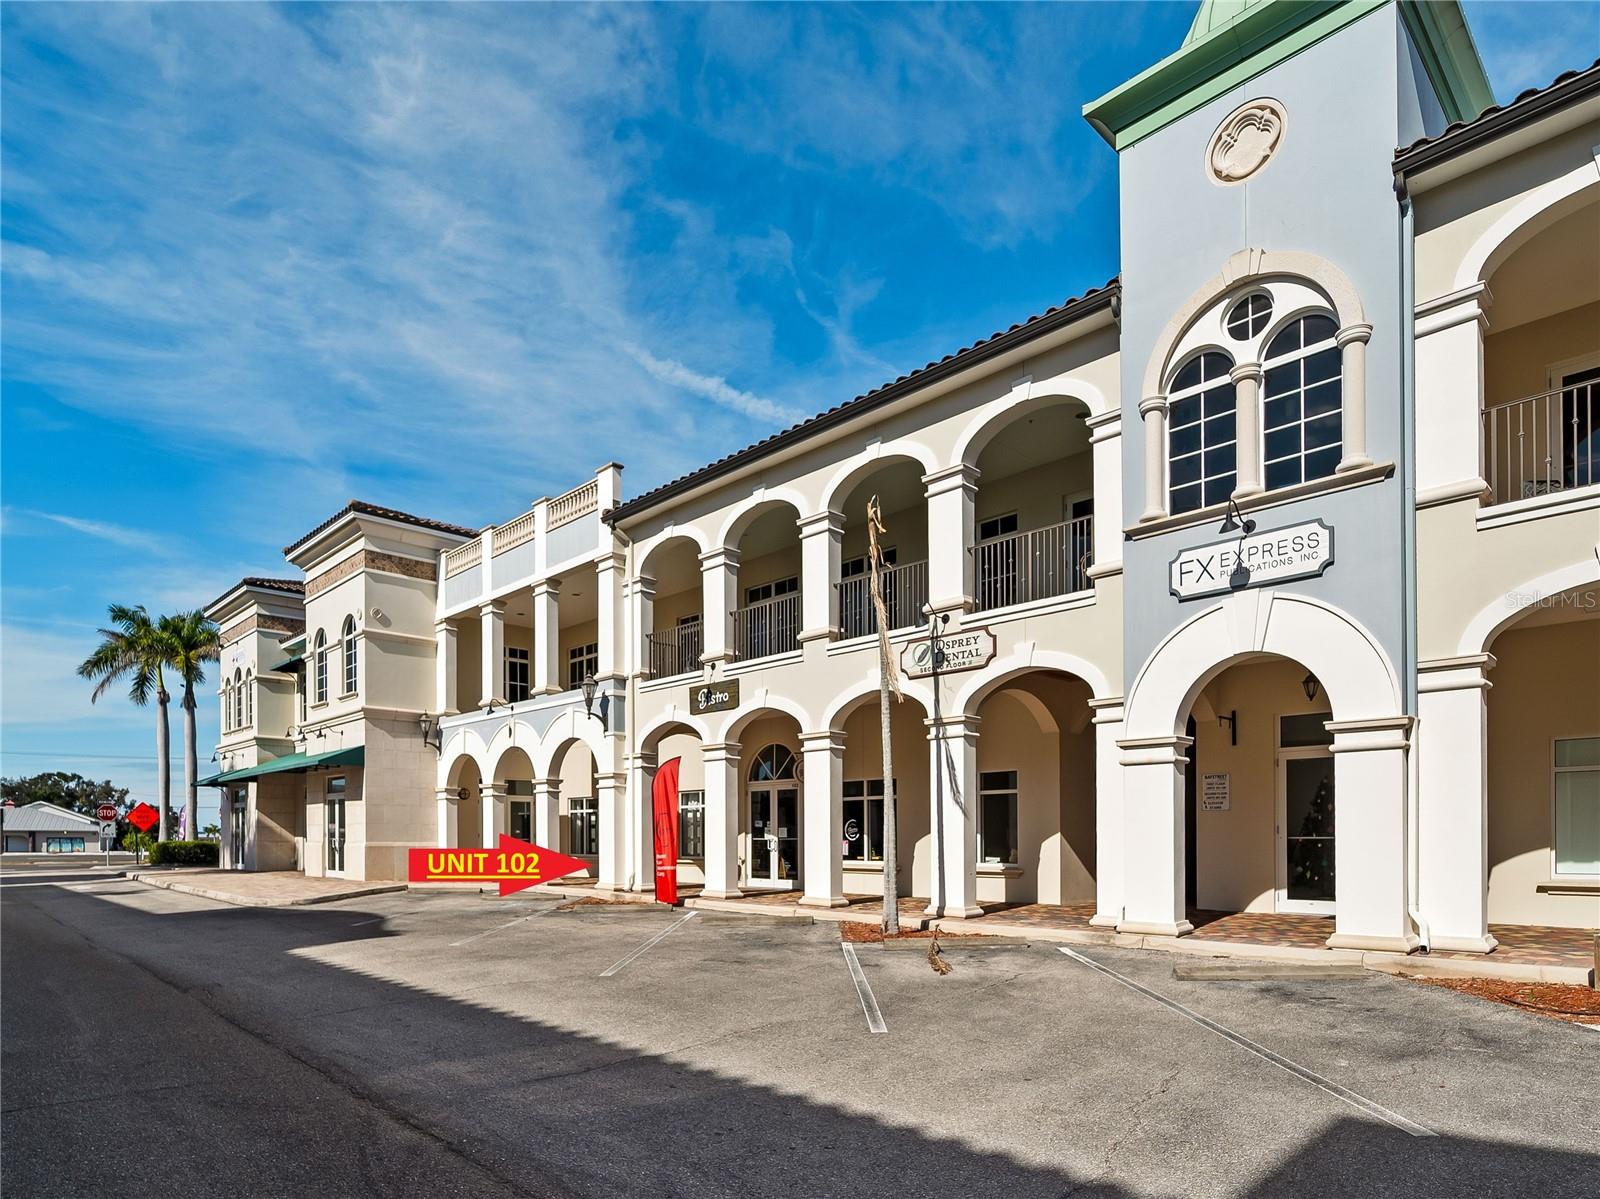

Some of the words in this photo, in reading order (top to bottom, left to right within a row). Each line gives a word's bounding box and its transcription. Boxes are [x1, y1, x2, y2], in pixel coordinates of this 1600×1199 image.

[1179, 554, 1215, 587] FX
[1219, 532, 1320, 568] EXPRESS
[1219, 556, 1294, 579] PUBLICATIONS
[935, 635, 981, 651] OSPREY
[935, 648, 982, 664] DENTAL
[698, 688, 729, 710] Bistro
[99, 809, 117, 817] STOP
